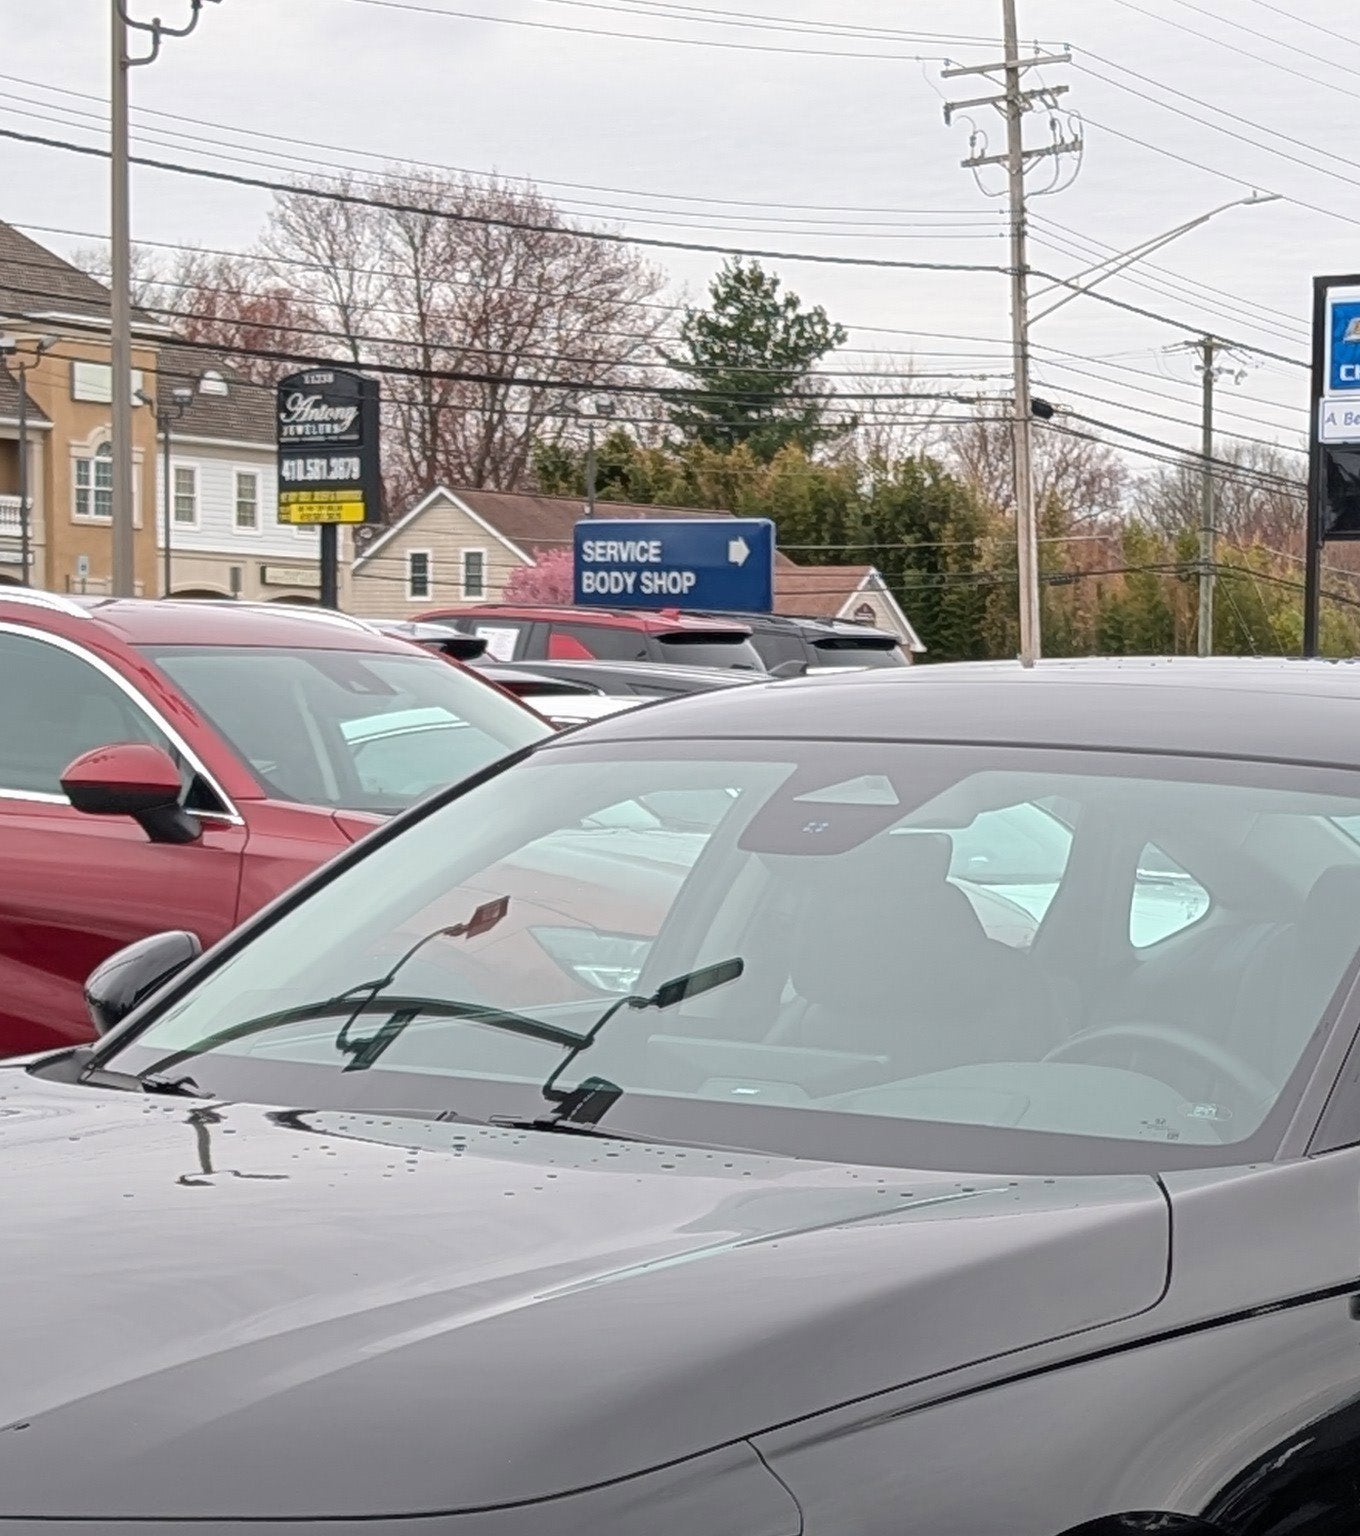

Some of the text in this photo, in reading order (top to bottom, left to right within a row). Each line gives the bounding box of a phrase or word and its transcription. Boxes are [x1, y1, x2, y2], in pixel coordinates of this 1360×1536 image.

[280, 392, 359, 432] Antony
[1325, 412, 1337, 426] A
[582, 540, 662, 563] SERVICE
[581, 571, 696, 594] BODY SHOP
